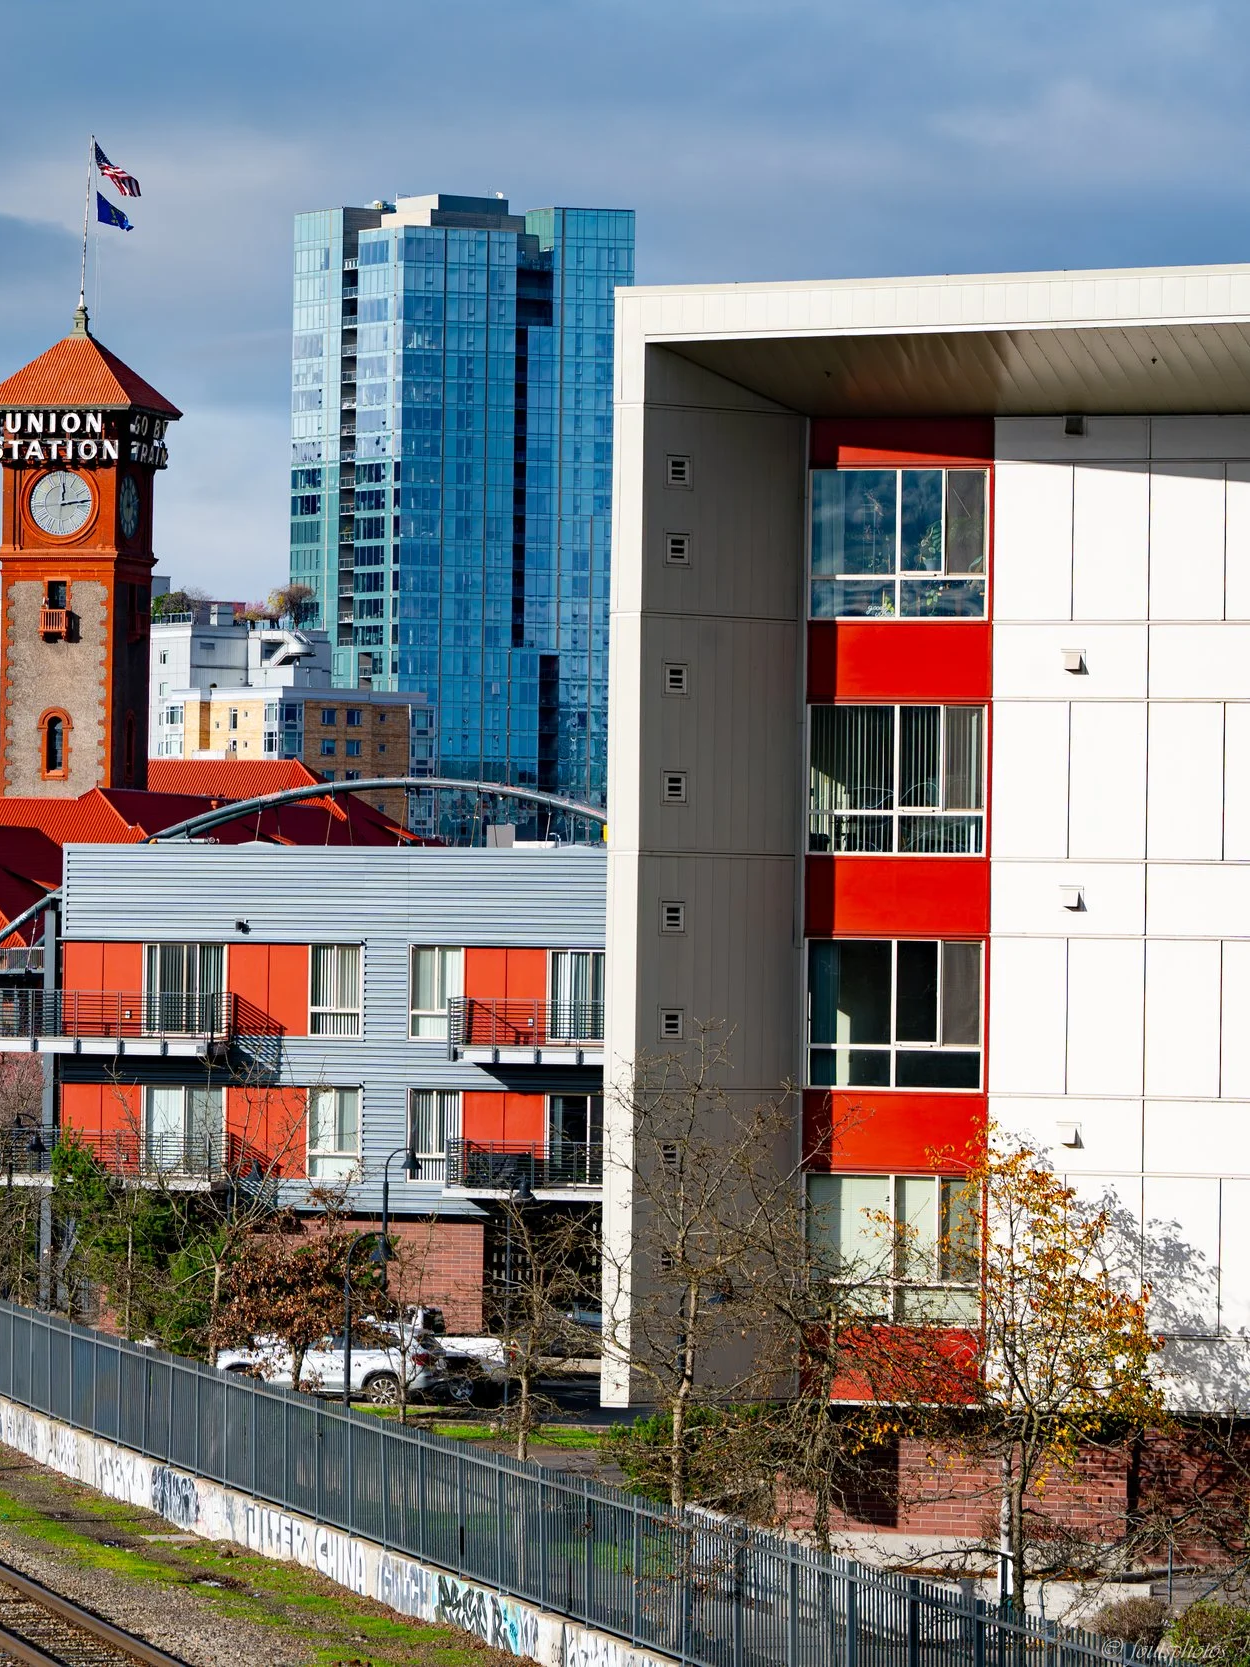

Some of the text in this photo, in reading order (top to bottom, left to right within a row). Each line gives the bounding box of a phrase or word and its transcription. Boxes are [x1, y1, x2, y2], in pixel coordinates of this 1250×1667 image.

[5, 412, 102, 433] UNION
[134, 414, 149, 436] GO
[132, 441, 168, 466] TRAIN
